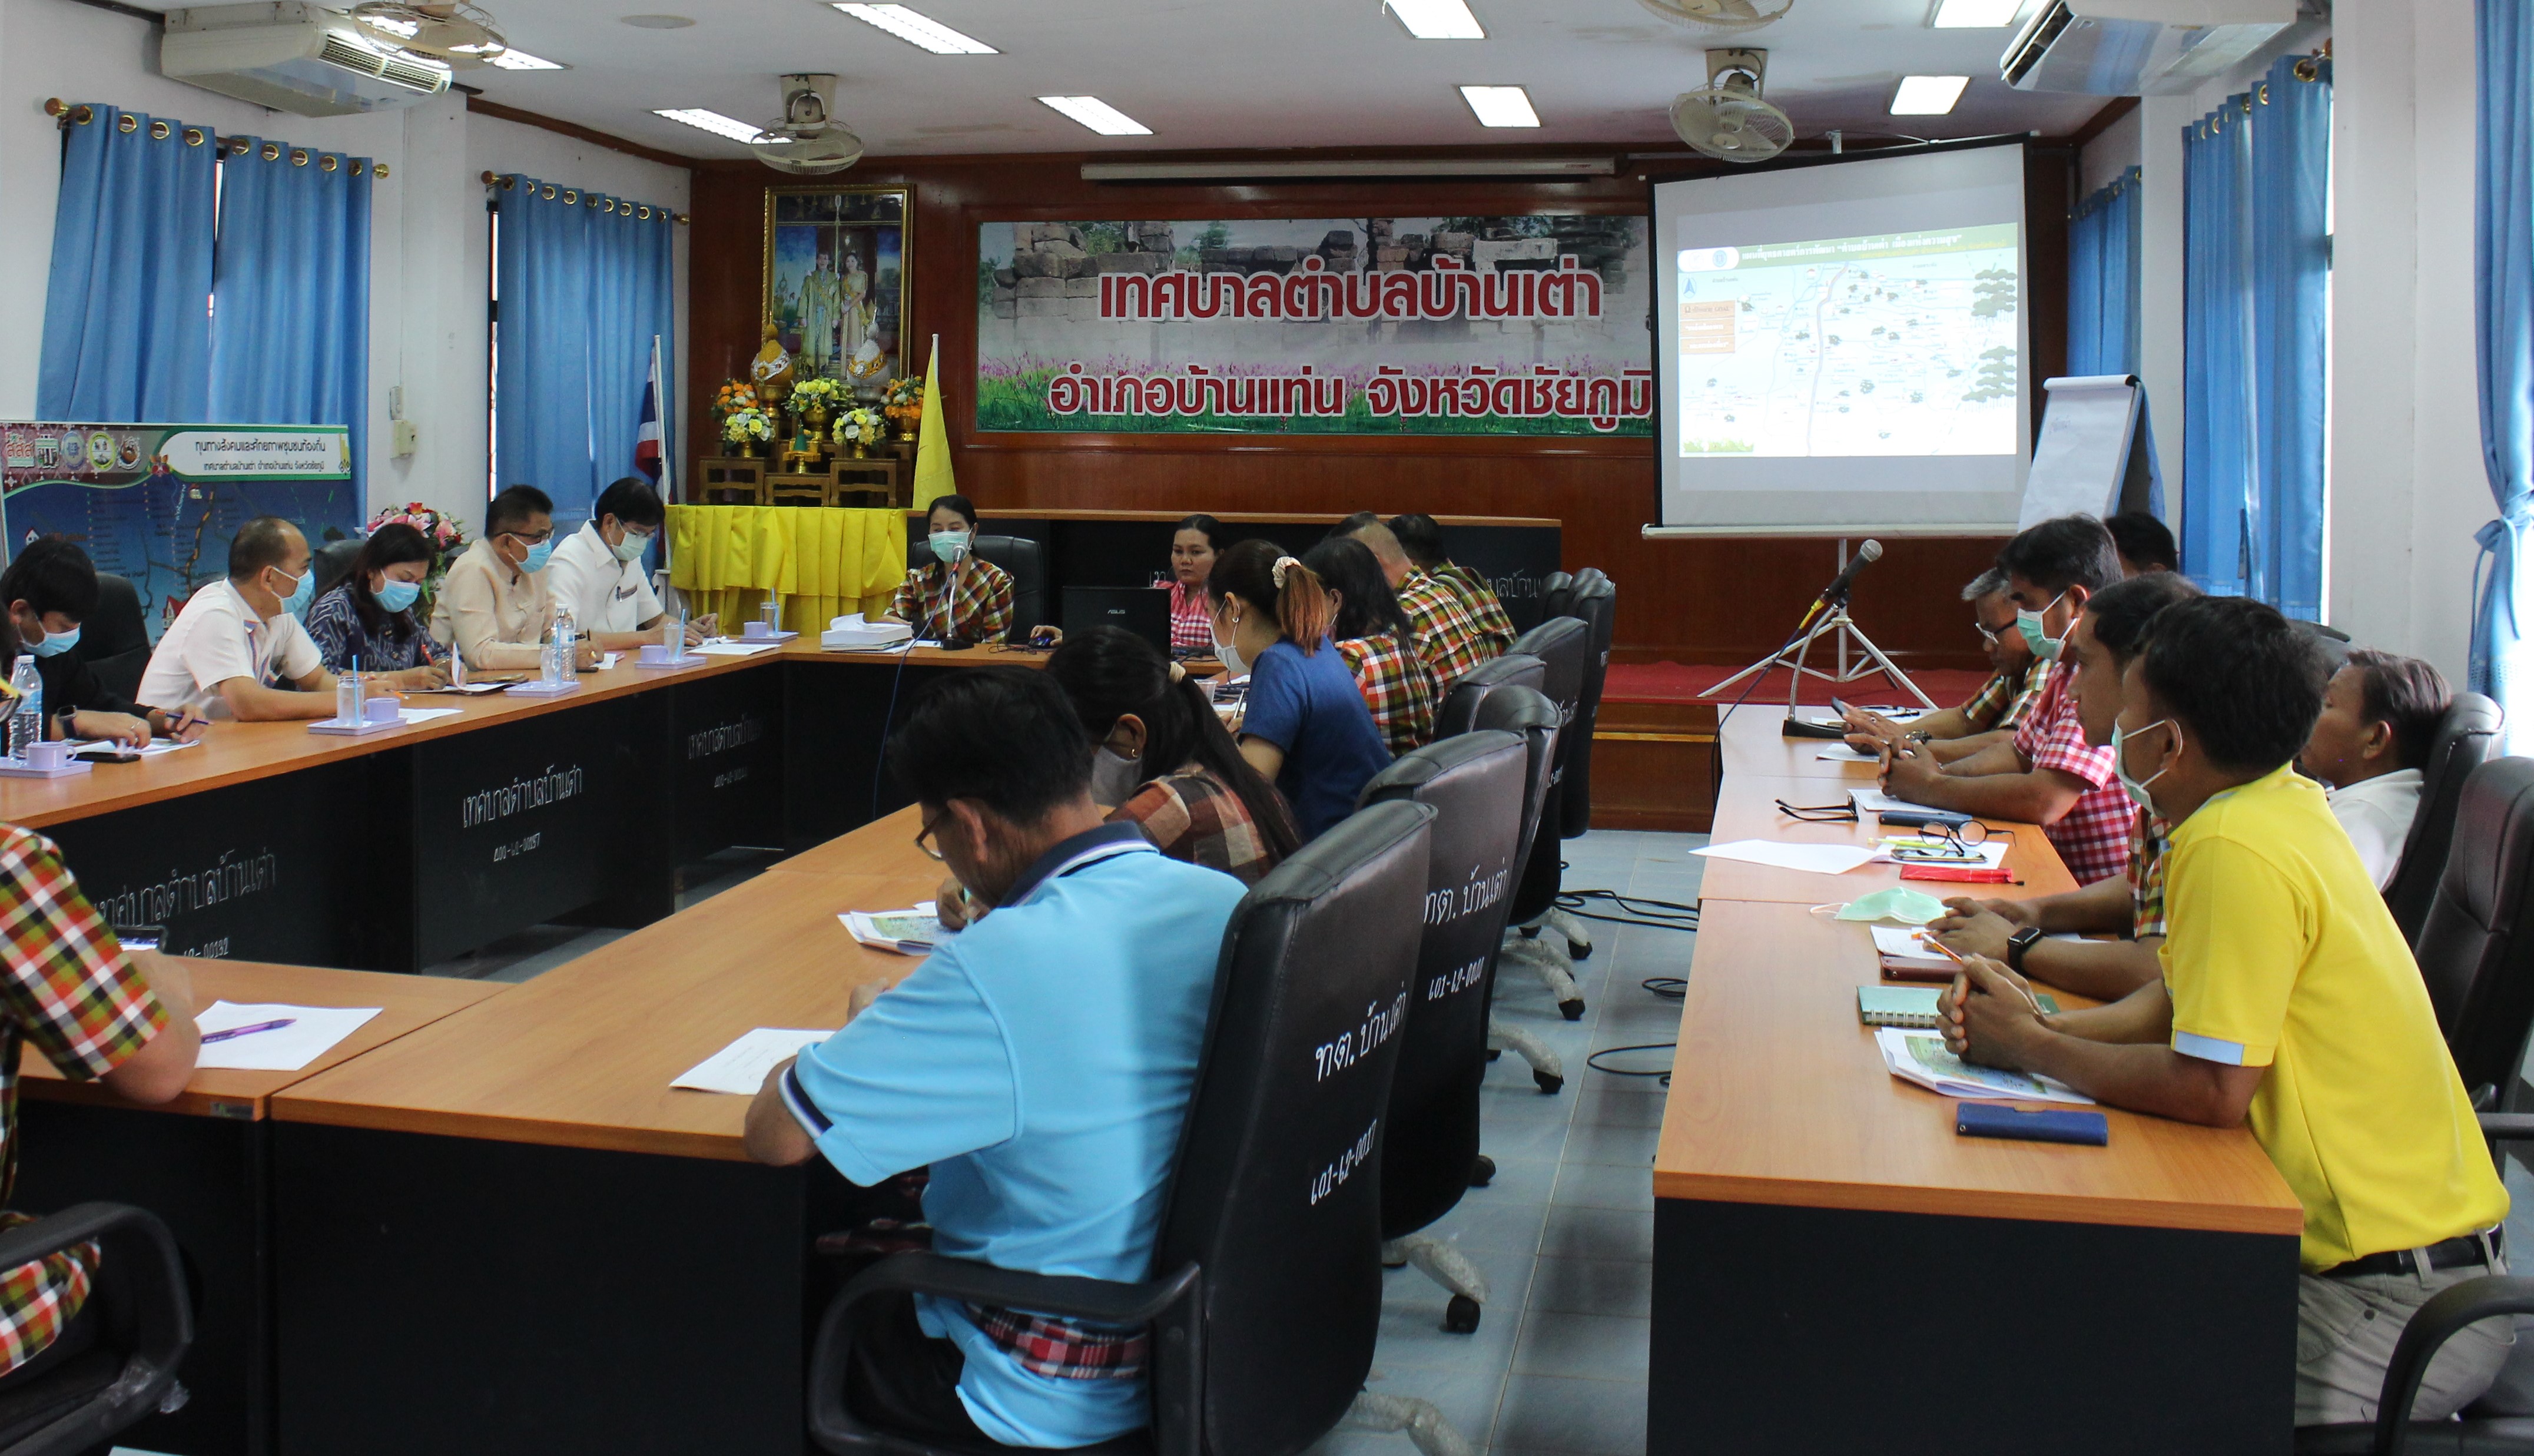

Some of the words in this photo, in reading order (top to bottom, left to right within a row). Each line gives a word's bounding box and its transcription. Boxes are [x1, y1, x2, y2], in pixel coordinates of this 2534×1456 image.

[1100, 256, 1600, 318] เทศบาลตำบลบ้านเต่า
[1052, 363, 1343, 414] อำเภอบ้านแท่น
[1369, 366, 1651, 429] จังหวัดชัยภูมิ
[463, 764, 582, 828] เทศบาลตำบลบ้านเต่า
[1315, 1032, 1355, 1082] ทต.
[1359, 980, 1407, 1057] บ้านเต่า
